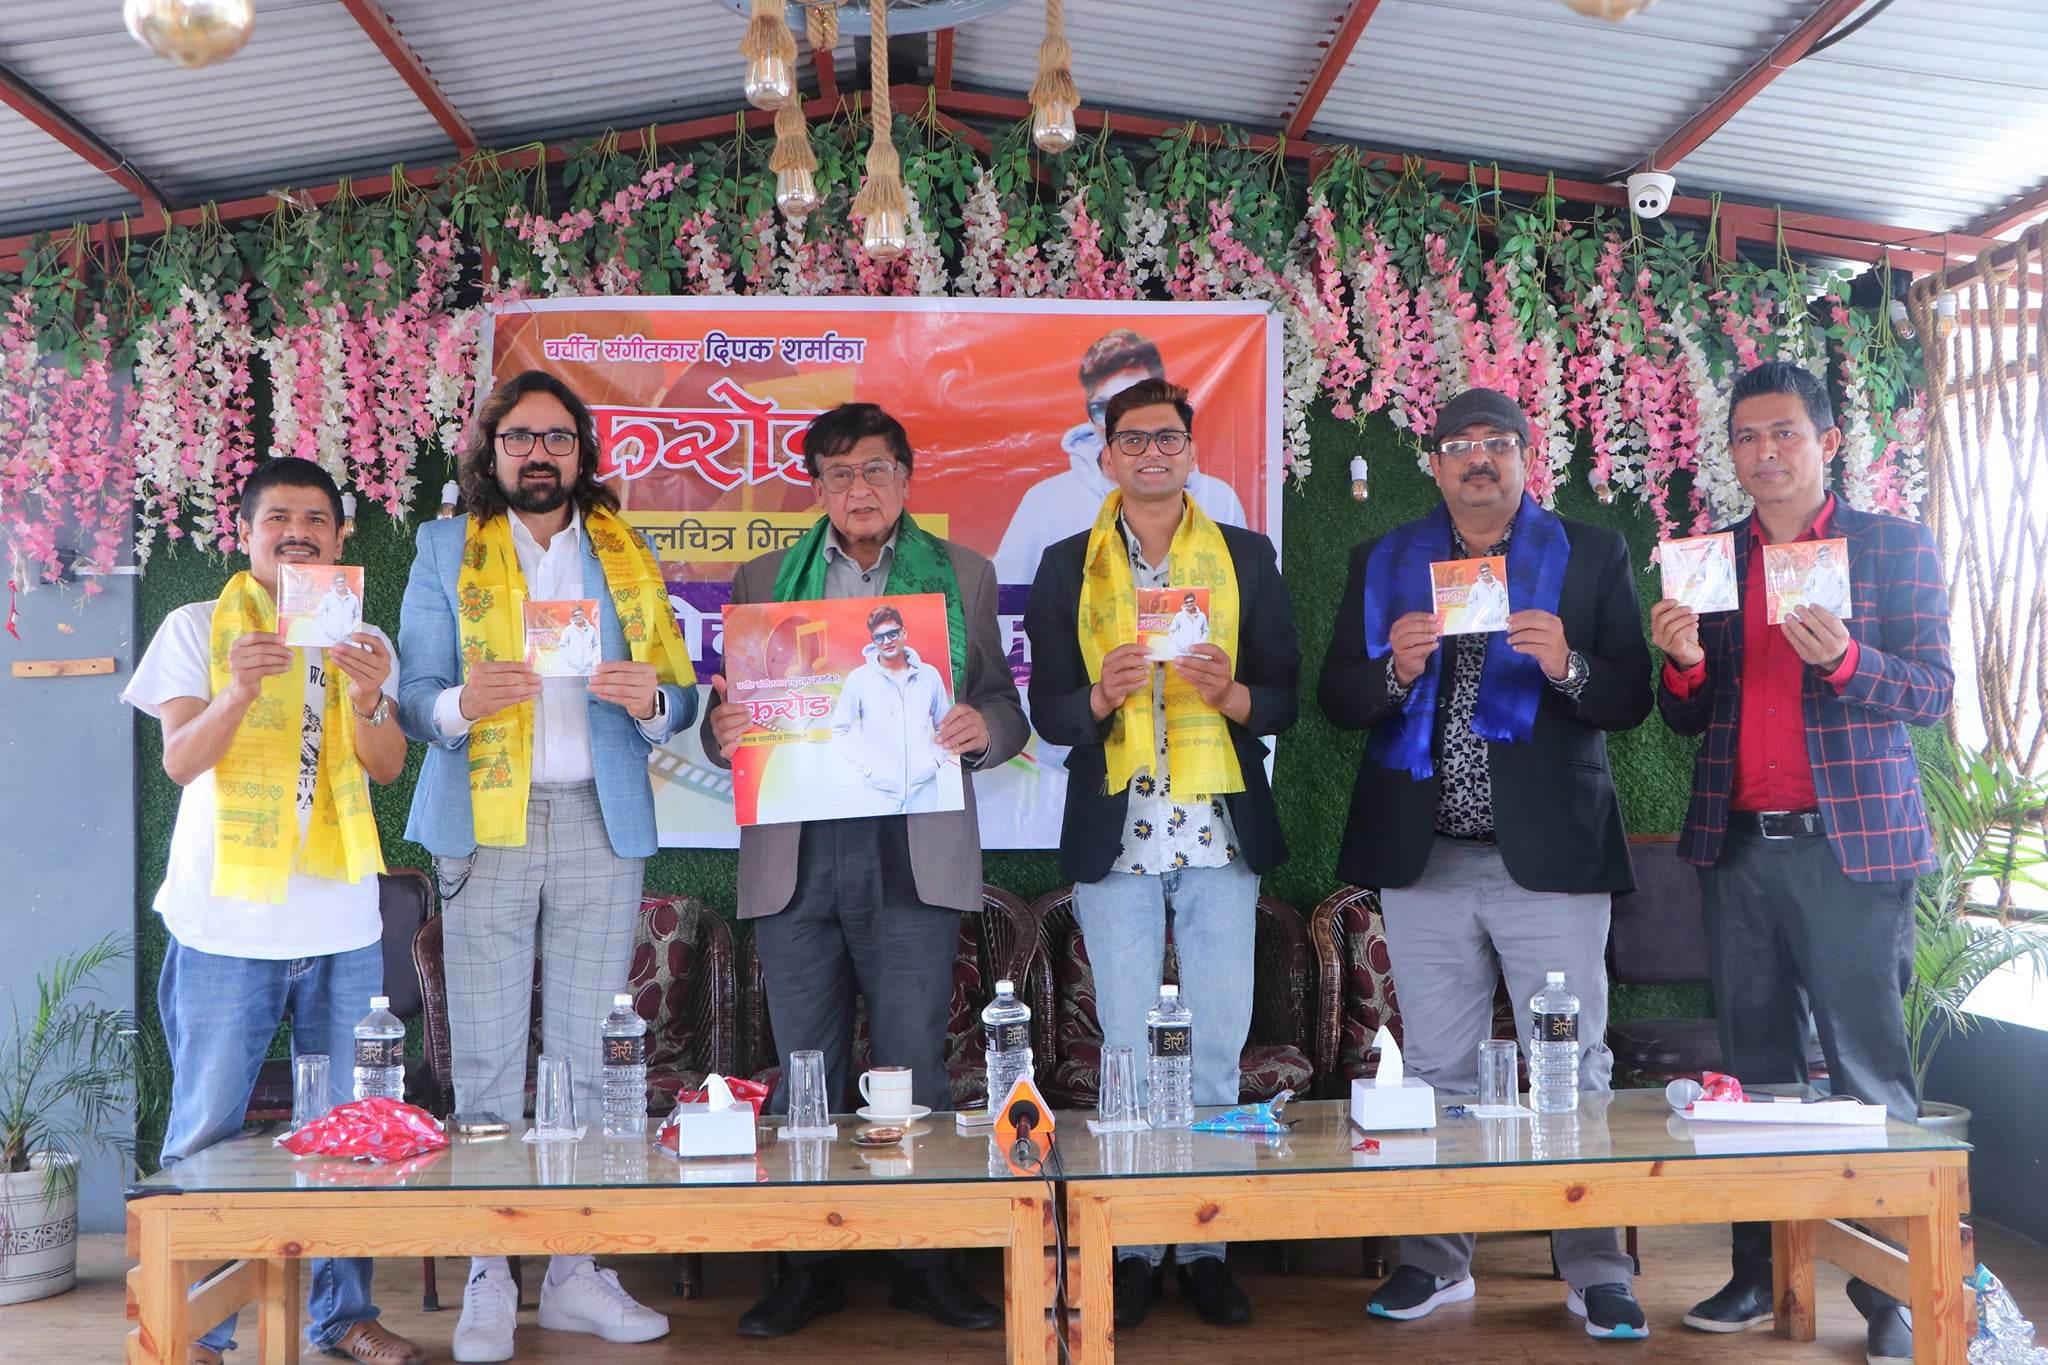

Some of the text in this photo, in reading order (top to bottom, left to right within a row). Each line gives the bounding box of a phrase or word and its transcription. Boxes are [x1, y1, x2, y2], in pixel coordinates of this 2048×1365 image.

[604, 337, 700, 360] संगीतकार
[706, 333, 773, 363] दिपक
[781, 334, 864, 362] शर्माका
